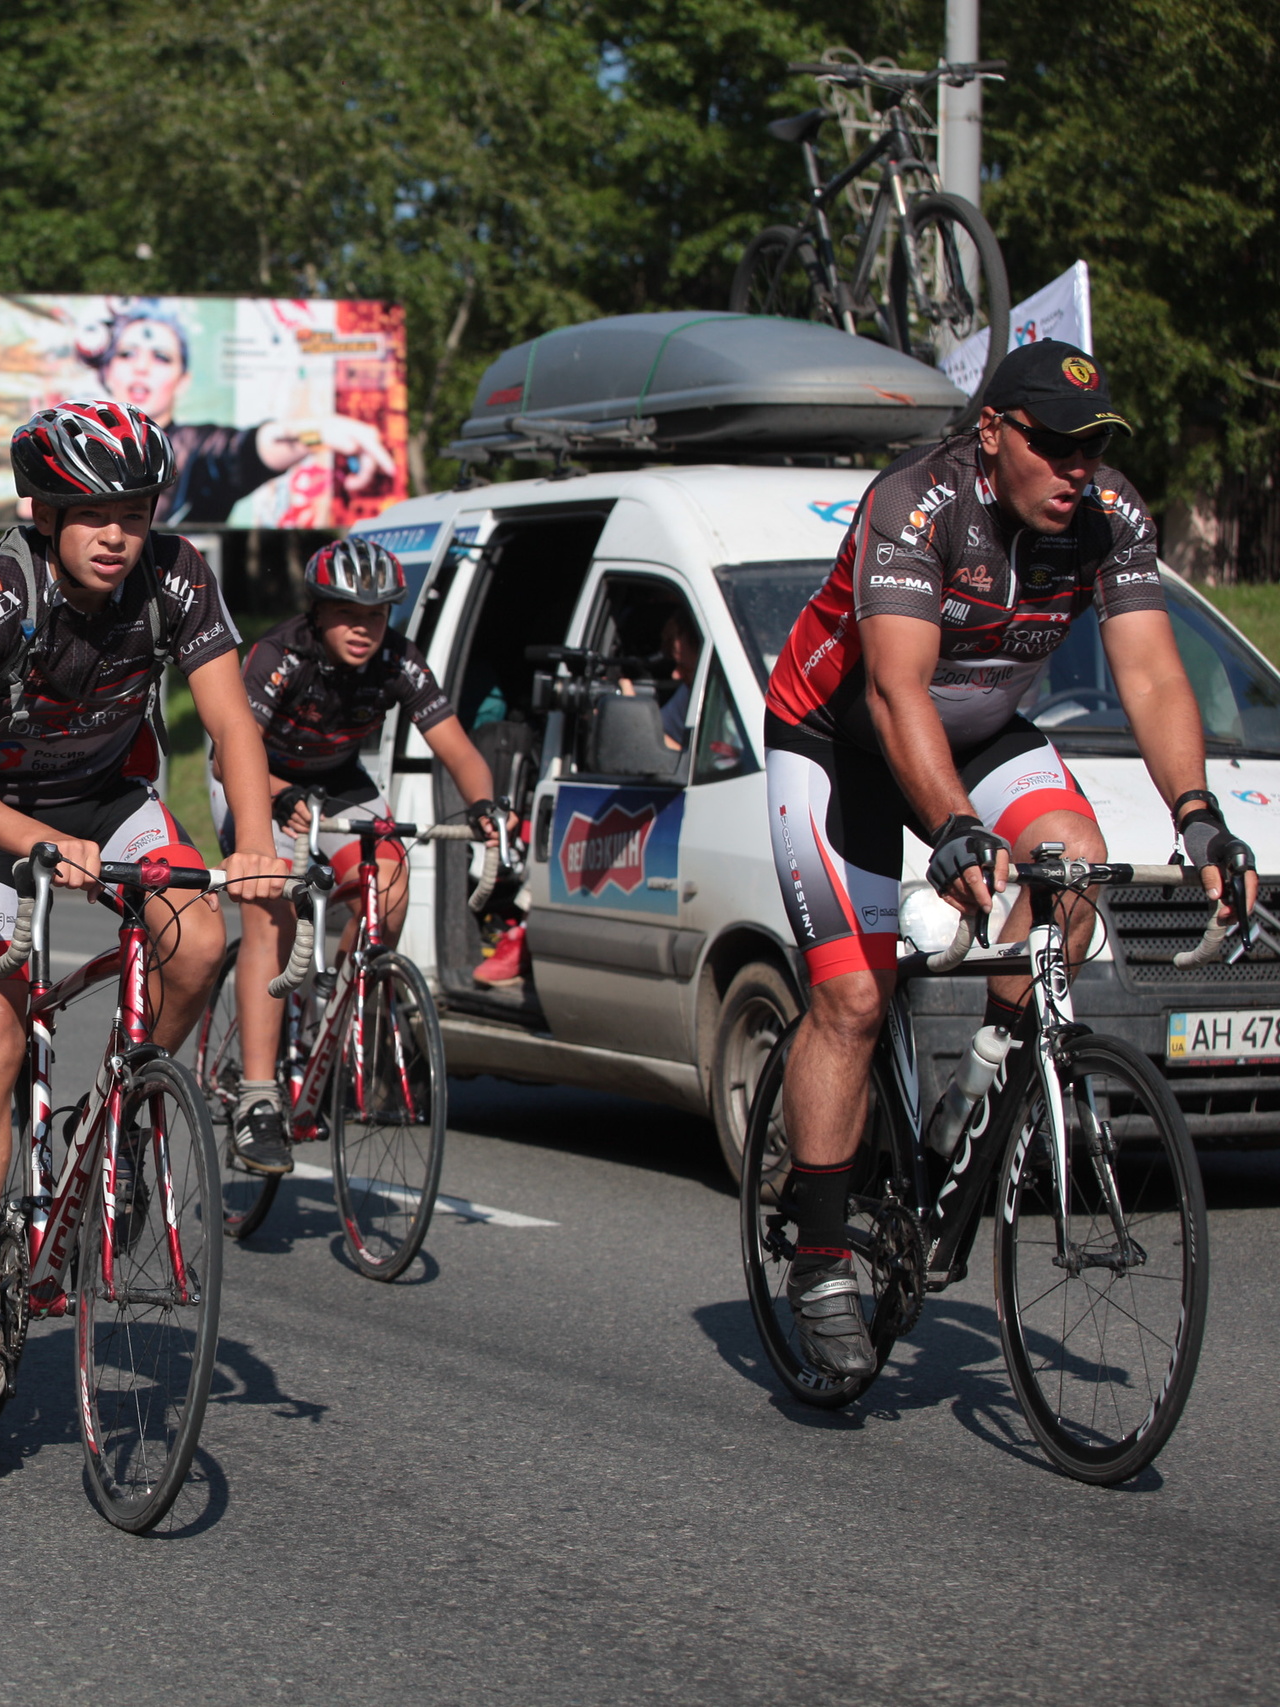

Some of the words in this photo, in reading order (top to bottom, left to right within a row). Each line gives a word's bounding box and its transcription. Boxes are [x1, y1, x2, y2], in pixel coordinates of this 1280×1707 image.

[1171, 1042, 1185, 1053] UA
[1191, 1018, 1231, 1051] AH
[46, 1169, 91, 1271] FUJI
